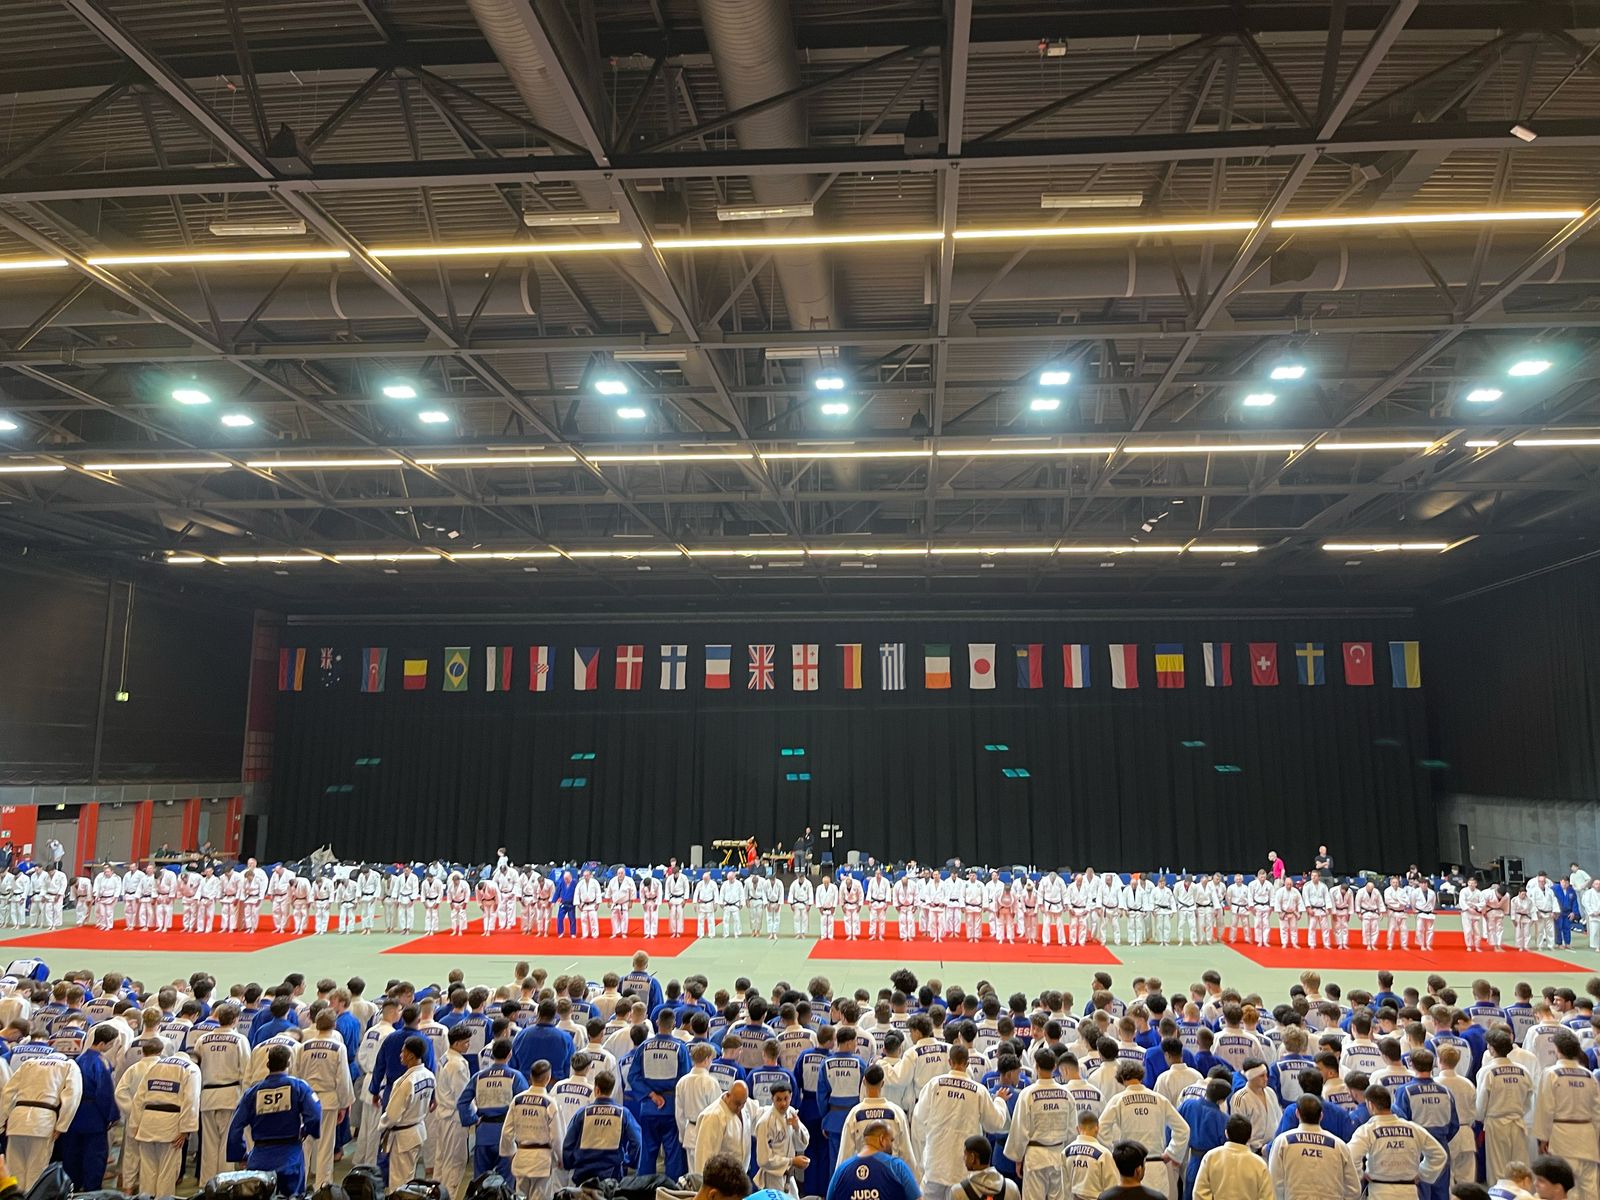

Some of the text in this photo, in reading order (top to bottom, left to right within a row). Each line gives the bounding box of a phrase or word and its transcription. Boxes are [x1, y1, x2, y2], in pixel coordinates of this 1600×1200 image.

[1228, 1047, 1246, 1055] GER
[310, 1052, 328, 1060] NED
[925, 1056, 942, 1064] BRA
[263, 1092, 284, 1105] SP
[947, 1090, 966, 1100] BRA
[564, 1096, 581, 1105] BRA
[1421, 1097, 1441, 1105] NED
[1043, 1103, 1060, 1111] BRA
[1134, 1107, 1149, 1116] GEO
[521, 1108, 539, 1117] BRA
[593, 1118, 612, 1127] BRA
[1386, 1140, 1405, 1149] AZE
[1301, 1148, 1323, 1158] AZE
[851, 1189, 879, 1200] JUDO
